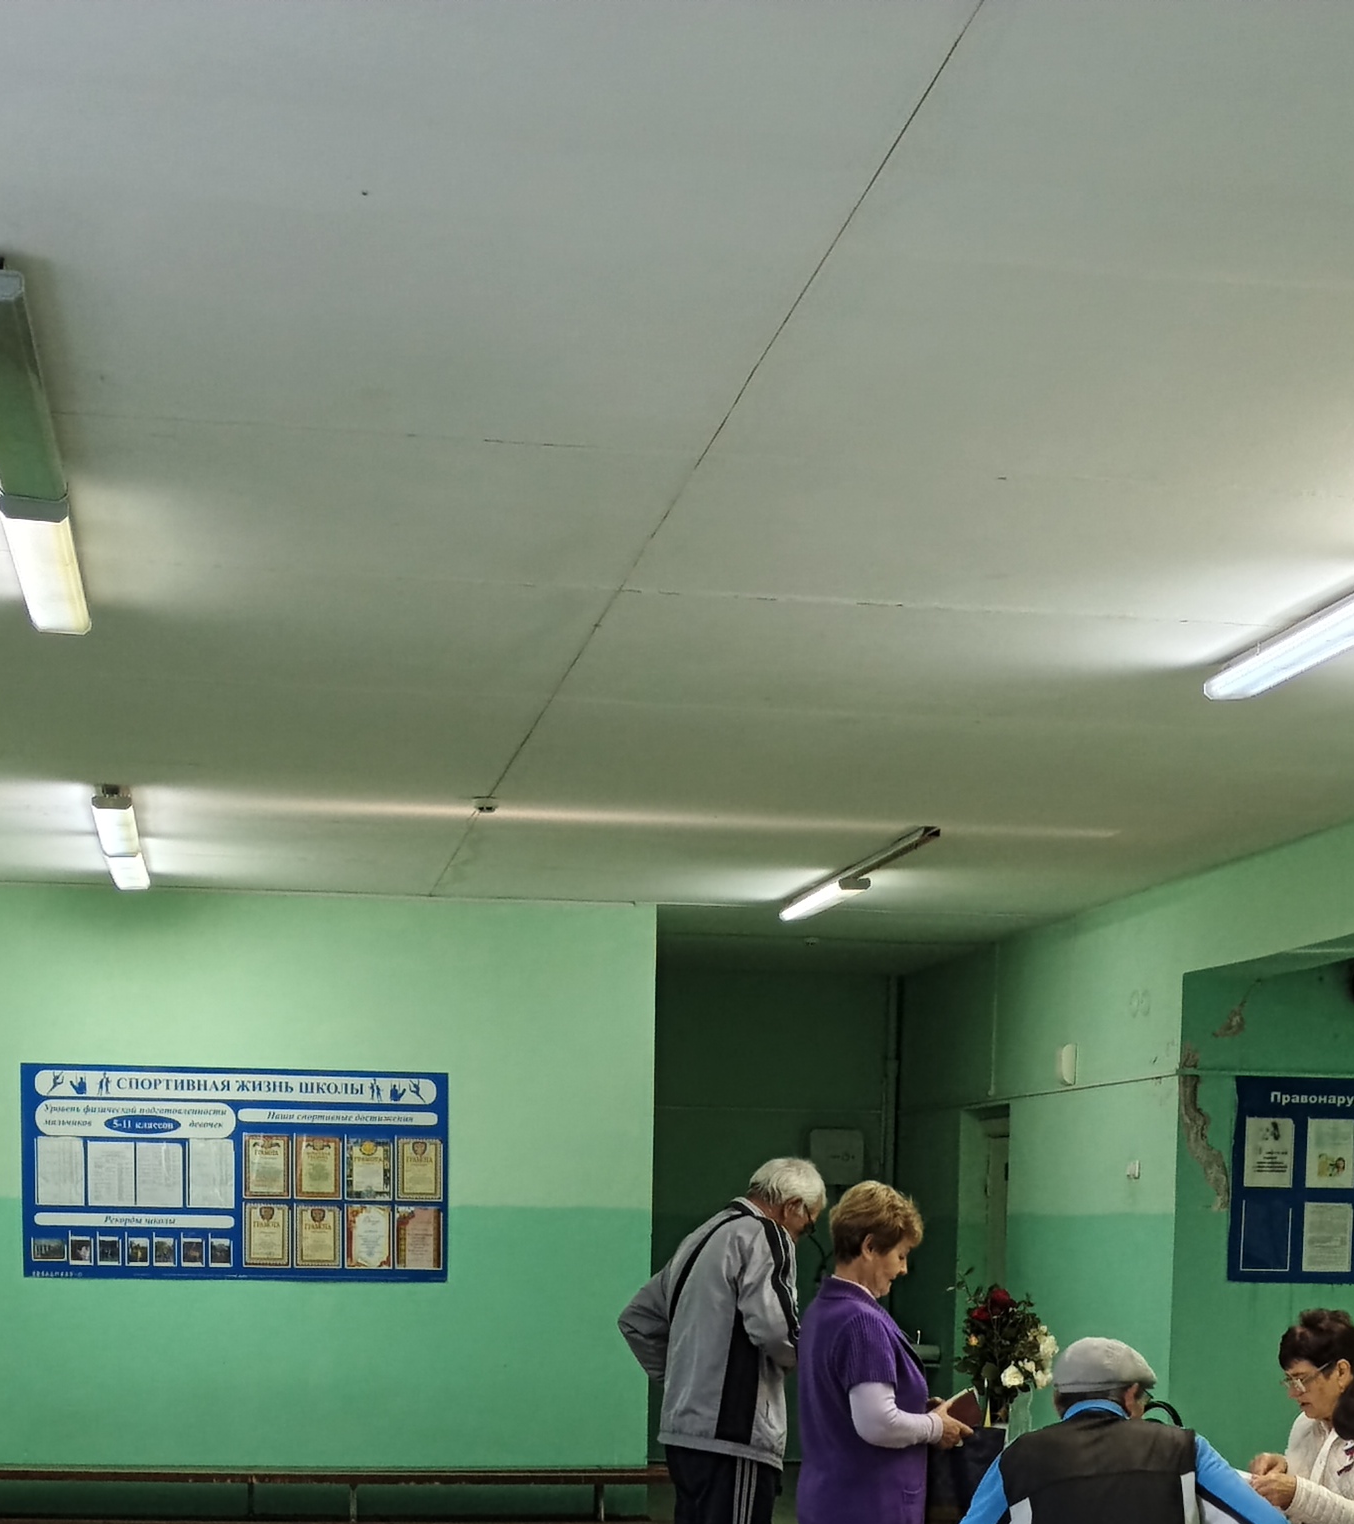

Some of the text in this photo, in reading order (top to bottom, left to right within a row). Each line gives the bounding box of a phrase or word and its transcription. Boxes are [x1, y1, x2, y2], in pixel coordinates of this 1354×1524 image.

[116, 1077, 365, 1096] СПОРТИВНАЯ ЖИЗНЬ ШКОЛЫ
[44, 1103, 227, 1116] Уровень физической подготовленности
[43, 1118, 92, 1127] мальчиков
[266, 1111, 414, 1124] Наши спортивные достижения
[112, 1120, 174, 1130] 5-11 классов
[188, 1120, 224, 1129] девочек
[104, 1215, 177, 1227] Рекорды школы
